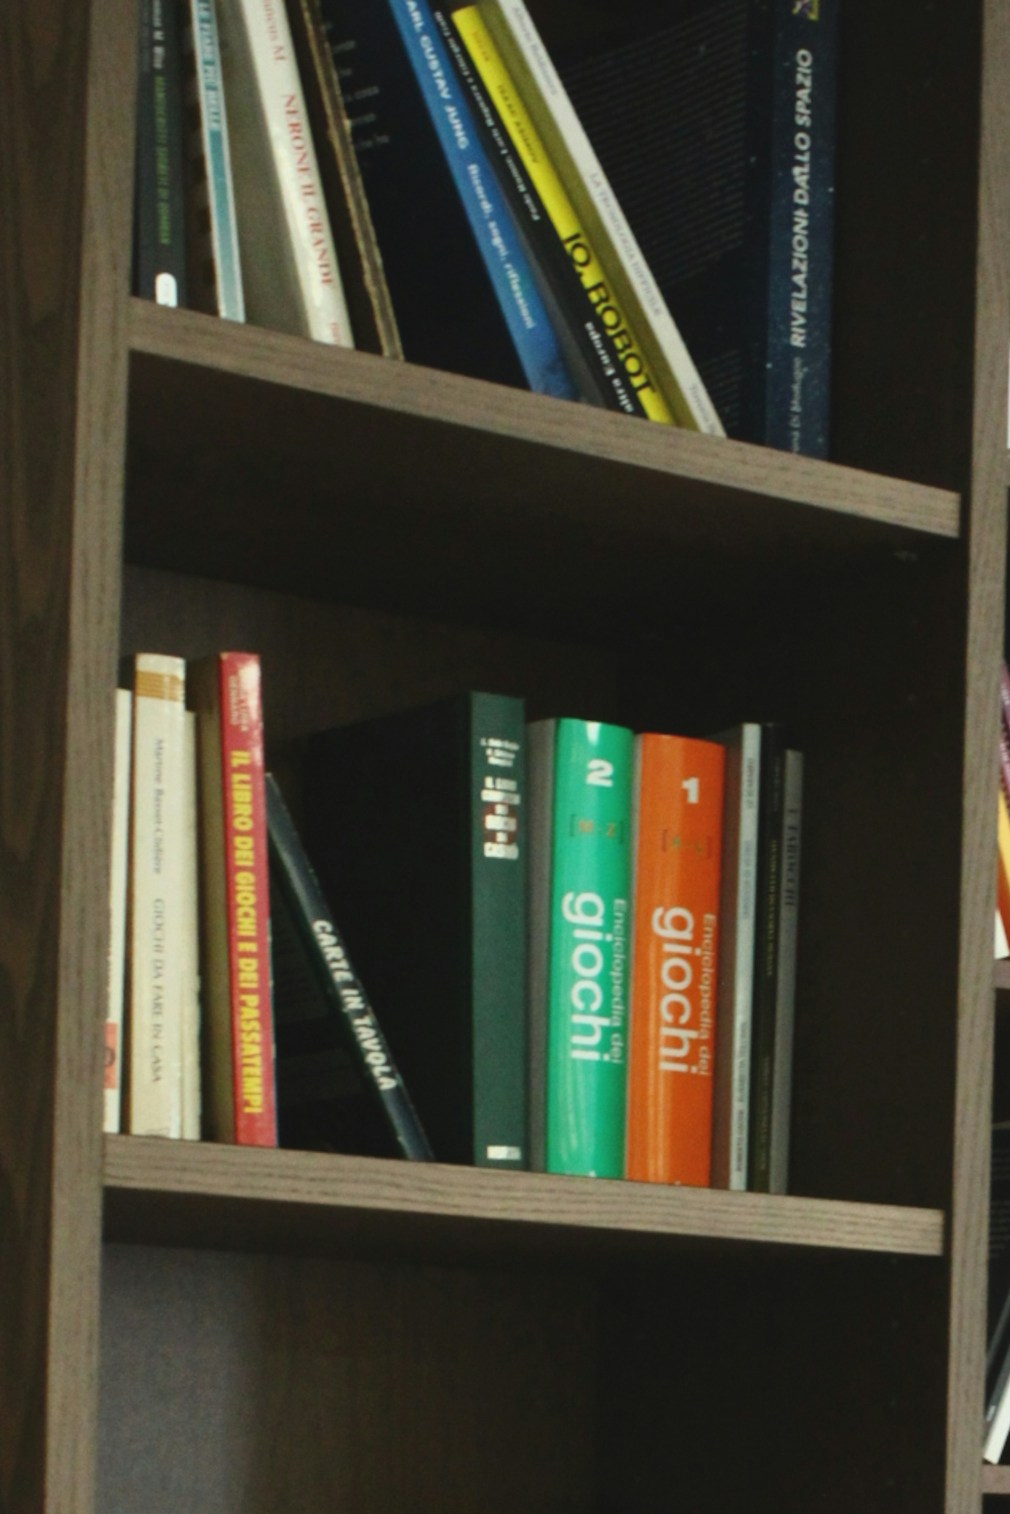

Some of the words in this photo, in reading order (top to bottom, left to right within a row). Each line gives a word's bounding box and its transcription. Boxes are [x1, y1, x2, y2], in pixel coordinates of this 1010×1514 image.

[417, 34, 452, 101] GUSTAV
[443, 102, 471, 151] JUNG
[792, 48, 813, 126] SPAZIO
[280, 92, 312, 176] NERONE
[300, 183, 316, 201] IL
[791, 131, 811, 205] DALLO
[305, 206, 335, 290] GRANDE
[464, 161, 497, 219] Ricordi,
[484, 219, 511, 263] sogni,
[502, 261, 538, 330] riflessioni
[788, 209, 810, 347] RIVELAZIONI
[561, 231, 599, 279] IO,
[584, 280, 657, 399] ROBOT
[581, 318, 619, 376] Europa
[154, 738, 165, 784] Martine
[230, 750, 247, 766] IL
[586, 760, 614, 787] 2
[230, 773, 251, 830] LIBRO
[681, 777, 700, 804] 1
[233, 836, 253, 867] DEI
[152, 898, 164, 951] GIOCHI
[234, 871, 258, 934] GIOCHI
[237, 957, 258, 989] DEI
[309, 915, 356, 987] CARTE
[562, 891, 612, 1063] giochi
[607, 897, 627, 1028] Enciclopedia
[697, 912, 716, 1041] Enciclopedia
[151, 984, 164, 1017] FARE
[337, 983, 367, 1017] IN
[647, 905, 702, 1074] giochi
[151, 1043, 163, 1082] CASA
[236, 992, 267, 1114] PASSATEMPI
[347, 1012, 401, 1094] TAVOLA
[608, 1032, 623, 1065] dei
[697, 1044, 711, 1077] dei
